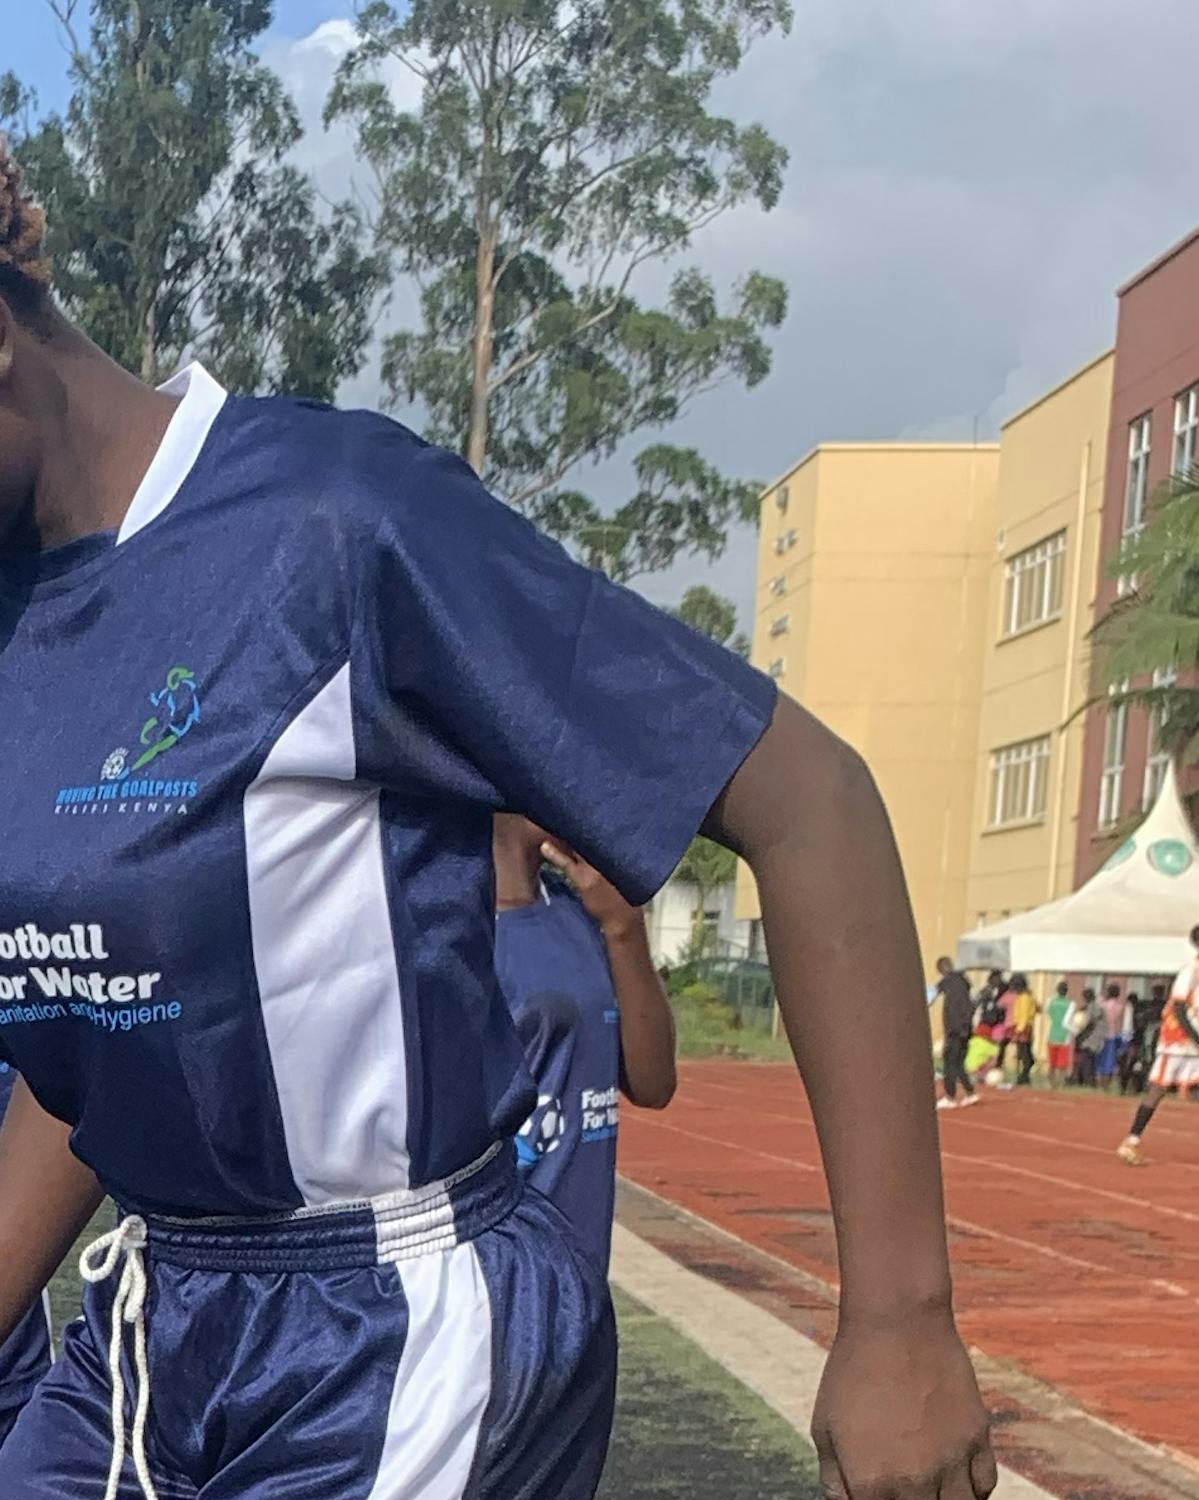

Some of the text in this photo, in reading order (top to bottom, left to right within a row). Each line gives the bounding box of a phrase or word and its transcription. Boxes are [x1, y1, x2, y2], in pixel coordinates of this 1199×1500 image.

[98, 783, 119, 800] THE
[121, 780, 198, 797] GOALPOSTS
[118, 802, 188, 815] KENYA
[28, 966, 161, 1003] Water
[93, 1001, 182, 1032] Hygiene
[582, 1111, 605, 1131] For
